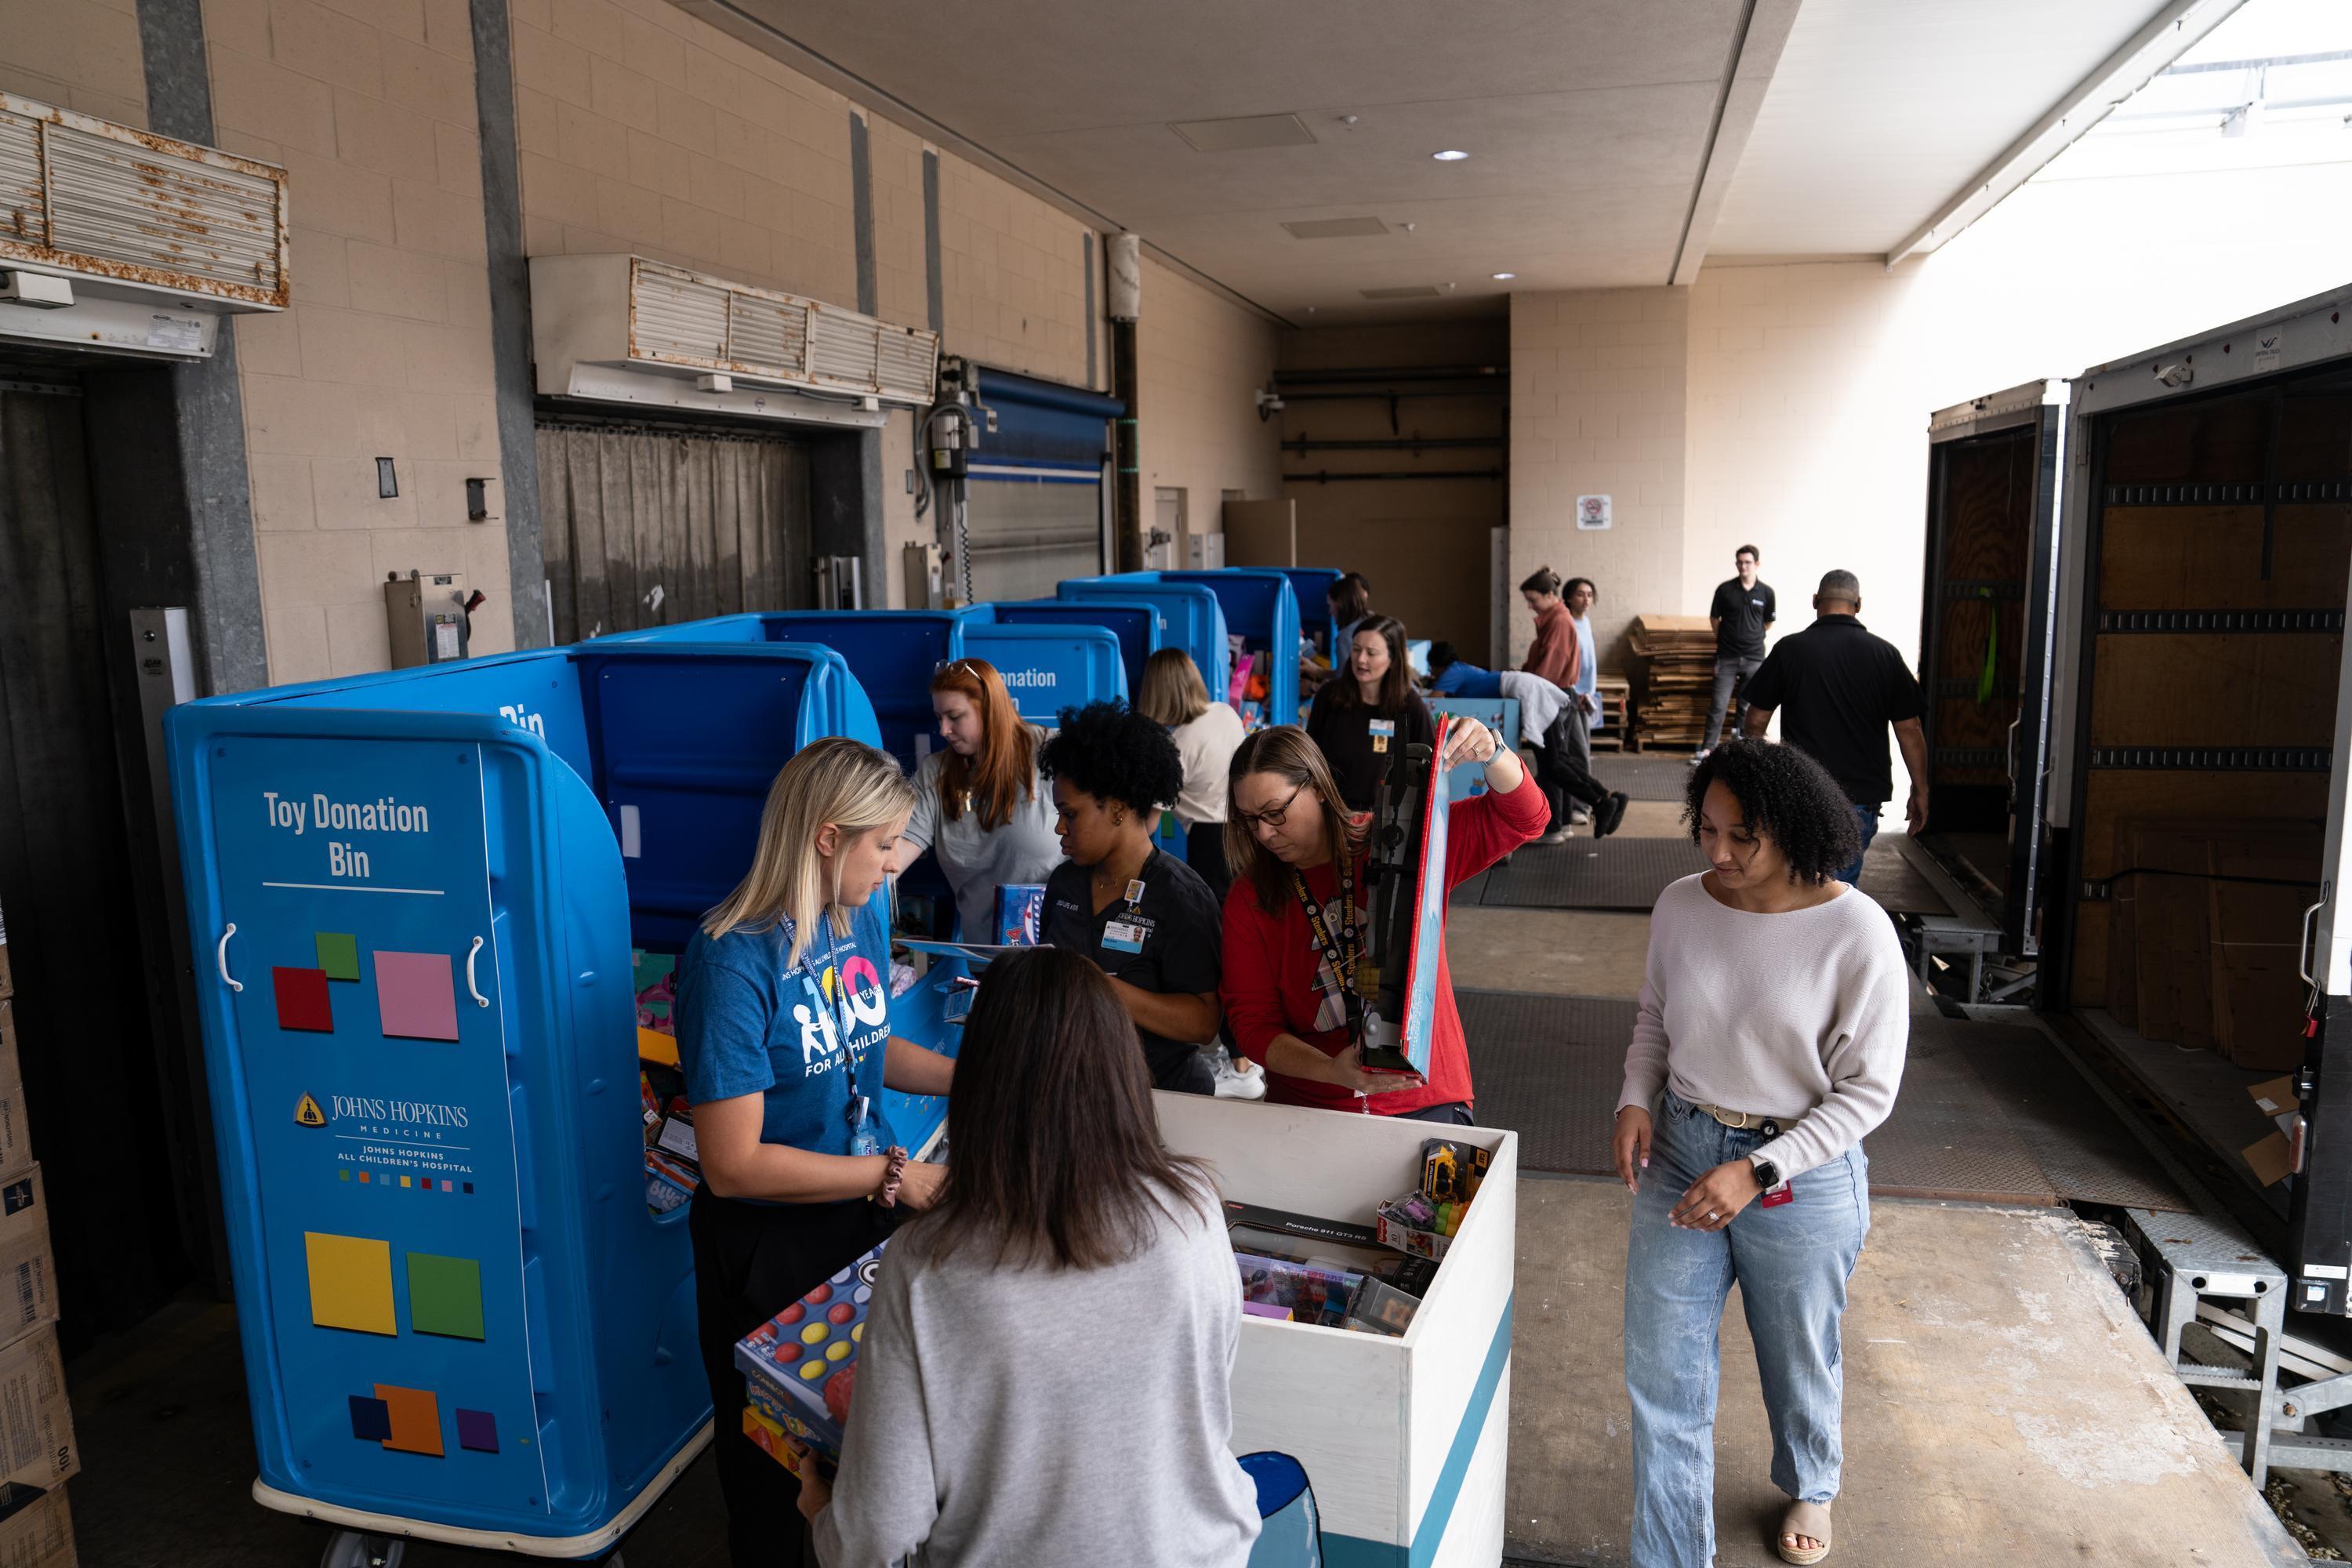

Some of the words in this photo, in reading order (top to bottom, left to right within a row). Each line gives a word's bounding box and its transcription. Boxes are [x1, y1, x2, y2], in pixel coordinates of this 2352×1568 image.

[999, 668, 1056, 687] onation
[263, 792, 307, 835] Toy
[314, 793, 429, 833] Donation
[328, 841, 370, 877] Bin
[1132, 915, 1156, 927] HOPKINS
[1345, 894, 1354, 925] Steelers
[1311, 915, 1329, 946] Steelers
[838, 942, 857, 953] HOSPITAL
[805, 1058, 832, 1077] FOR
[849, 1022, 891, 1051] HILDREN
[332, 1095, 387, 1120] JOHNS
[390, 1101, 469, 1127] HOPKINS
[360, 1125, 442, 1139] MEDICINE
[338, 1152, 356, 1161] ALL
[359, 1155, 419, 1167] CHILDREN'S
[423, 1161, 473, 1173] HOSPITAL
[363, 1145, 395, 1155] JOHNS
[398, 1147, 445, 1160] HOPKINS
[1285, 1221, 1319, 1232] Porsche
[57, 1446, 71, 1472] 100
